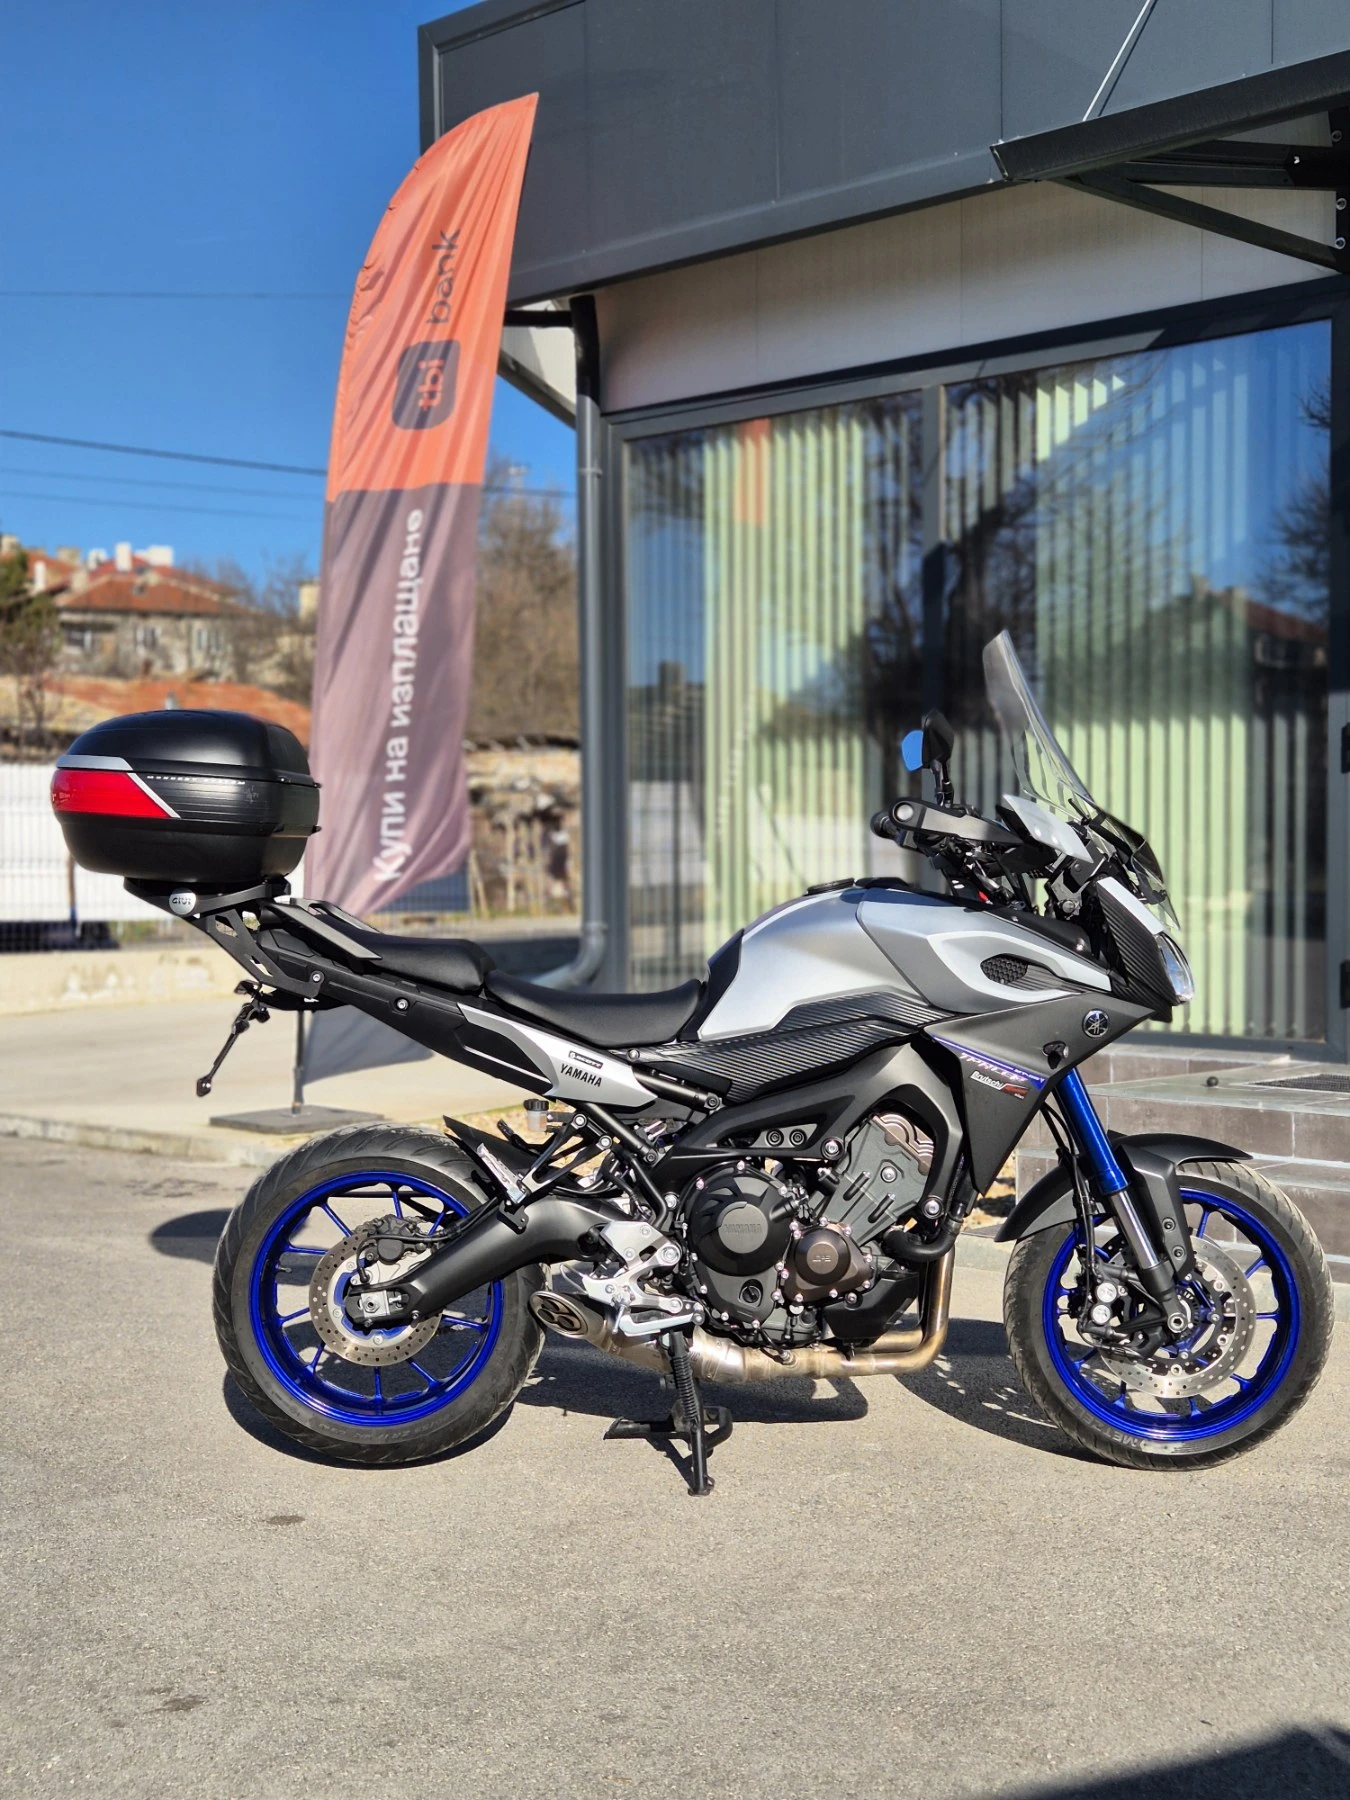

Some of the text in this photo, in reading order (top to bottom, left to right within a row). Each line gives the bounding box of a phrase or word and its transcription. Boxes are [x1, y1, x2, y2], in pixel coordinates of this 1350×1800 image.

[427, 229, 461, 325] bank
[373, 508, 425, 882] Купи на изплащане
[560, 1063, 602, 1088] YAMAHA
